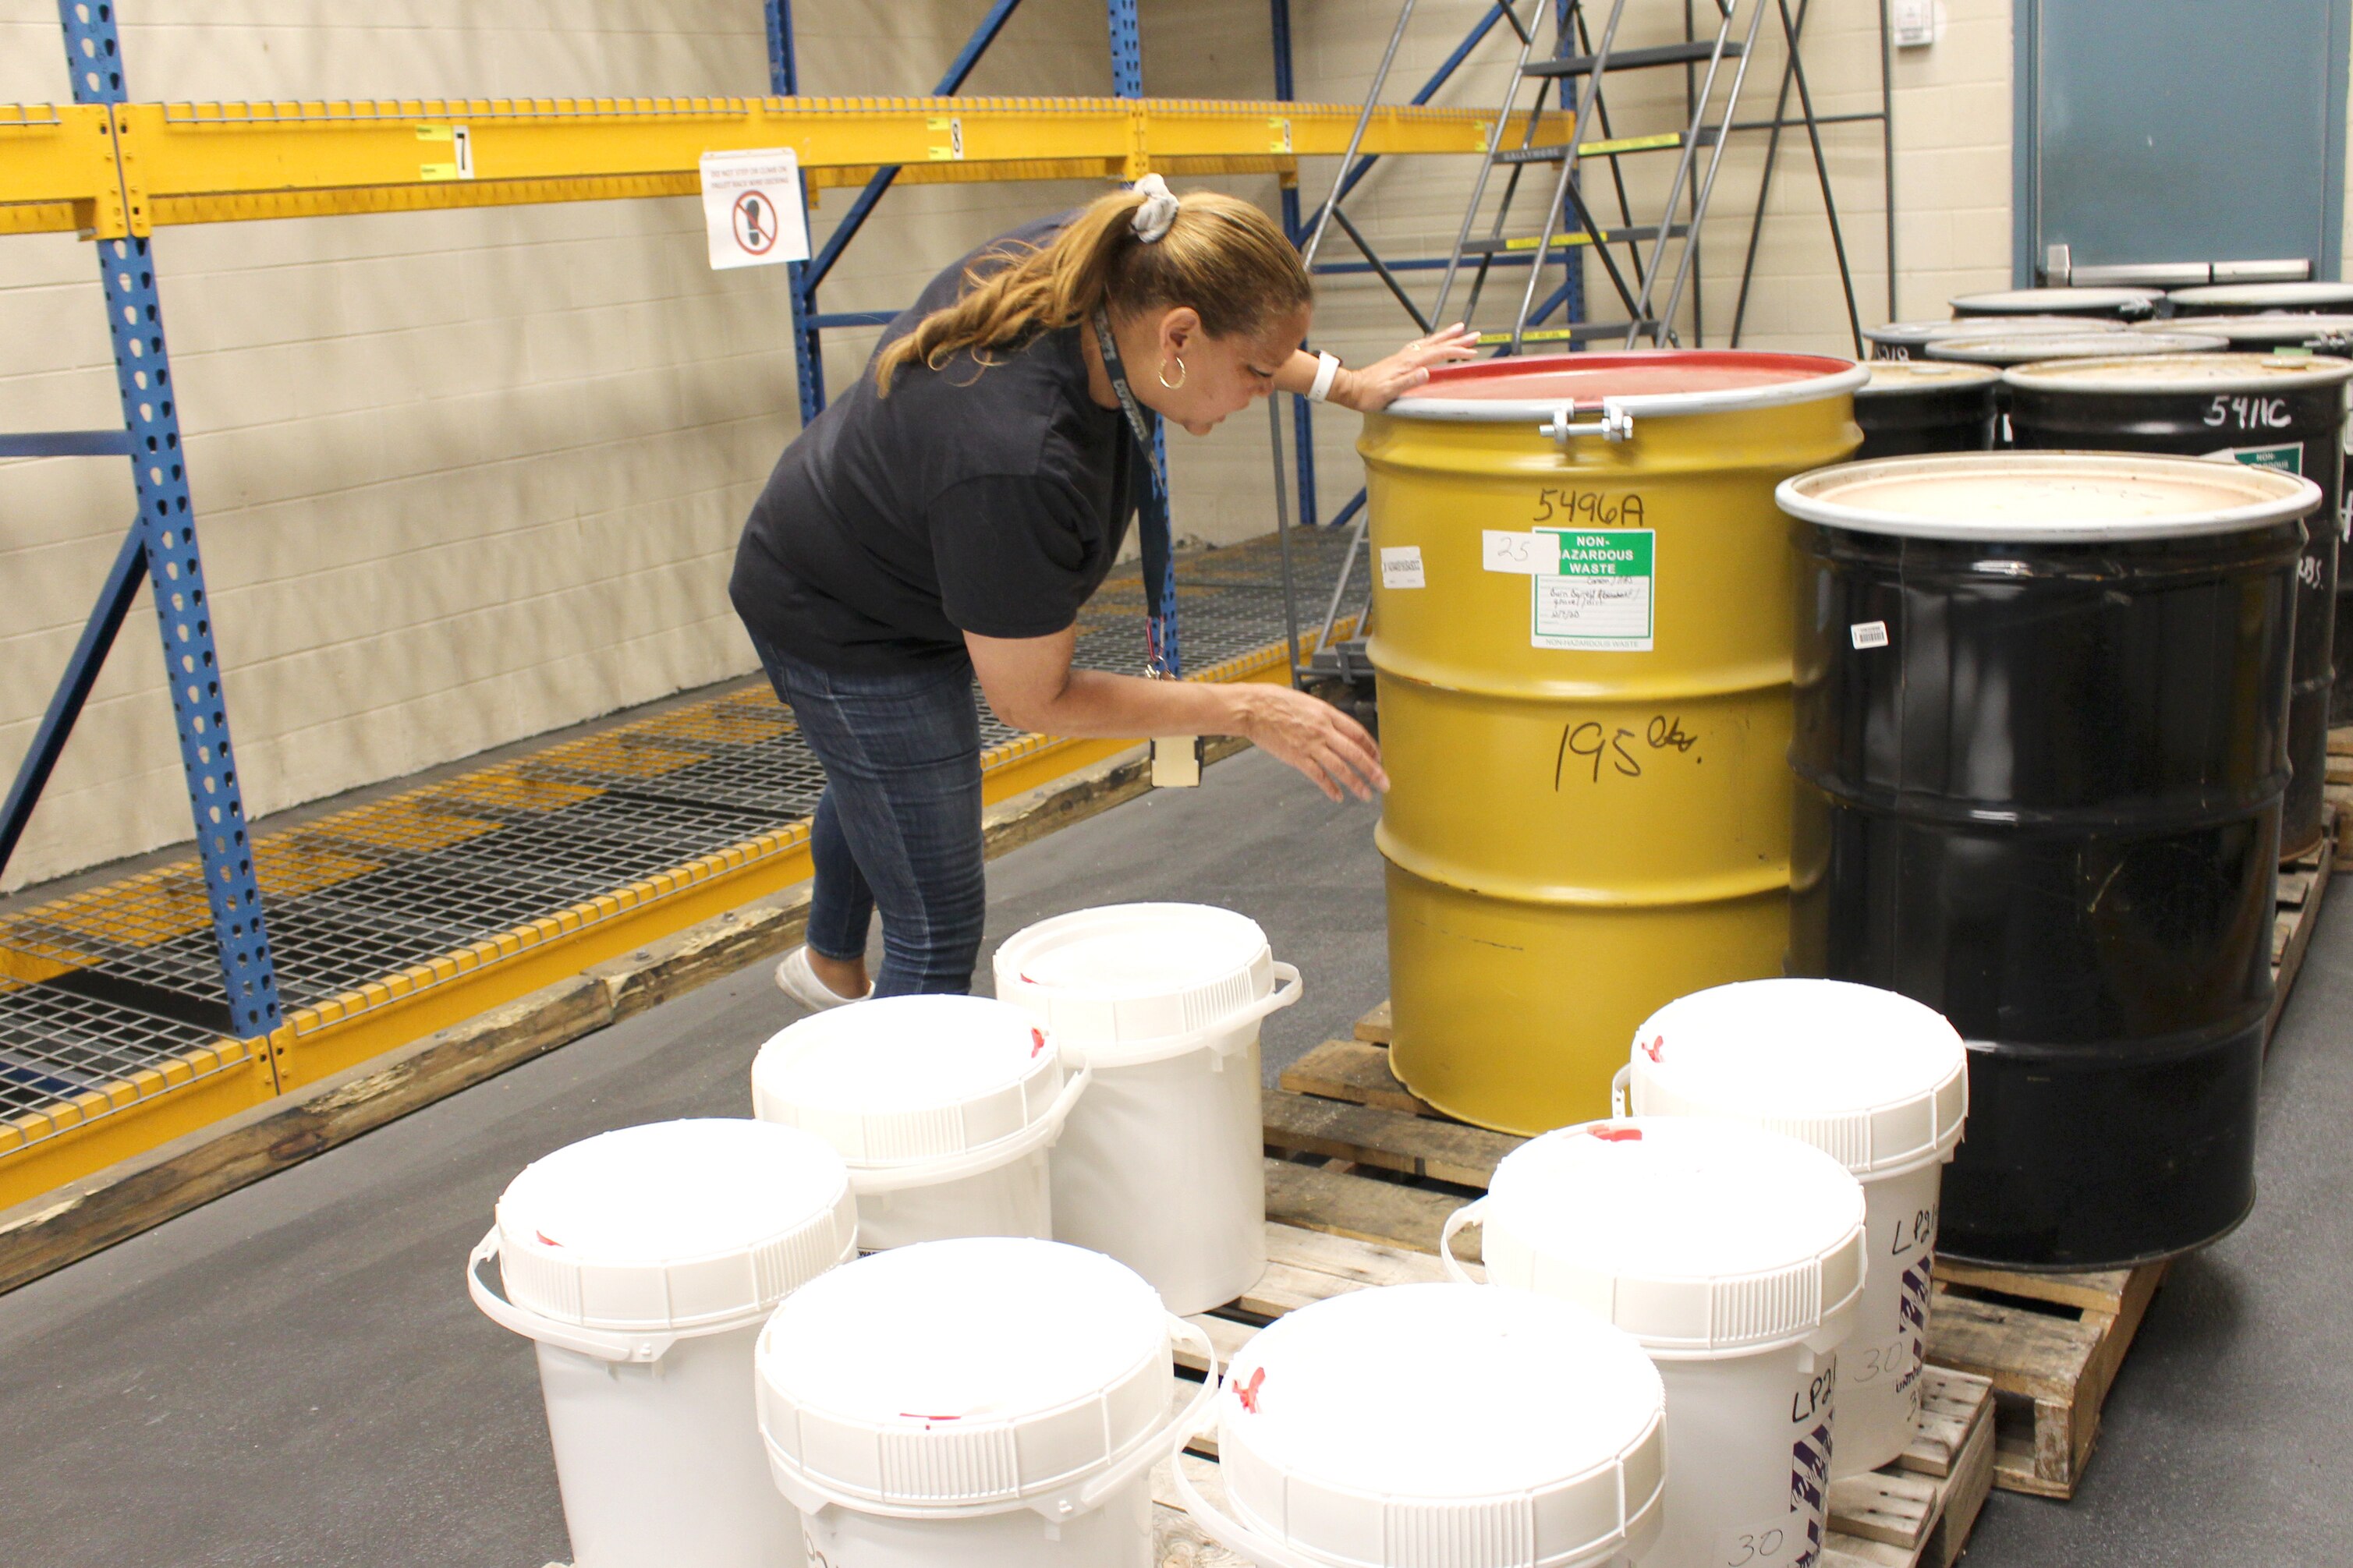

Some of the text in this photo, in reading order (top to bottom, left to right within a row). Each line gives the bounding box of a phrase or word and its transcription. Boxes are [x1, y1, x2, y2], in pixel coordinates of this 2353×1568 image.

[455, 132, 466, 170] 7
[1533, 488, 1644, 528] 5496A
[1497, 536, 1530, 562] 25
[1561, 549, 1635, 561] AZARDOUS
[1576, 536, 1611, 547] NON-
[1569, 563, 1617, 575] WASTE
[1612, 639, 1639, 649] WASTE
[1555, 721, 1641, 792] 195
[1855, 1341, 1903, 1383] 30
[1728, 1528, 1784, 1568] 30
